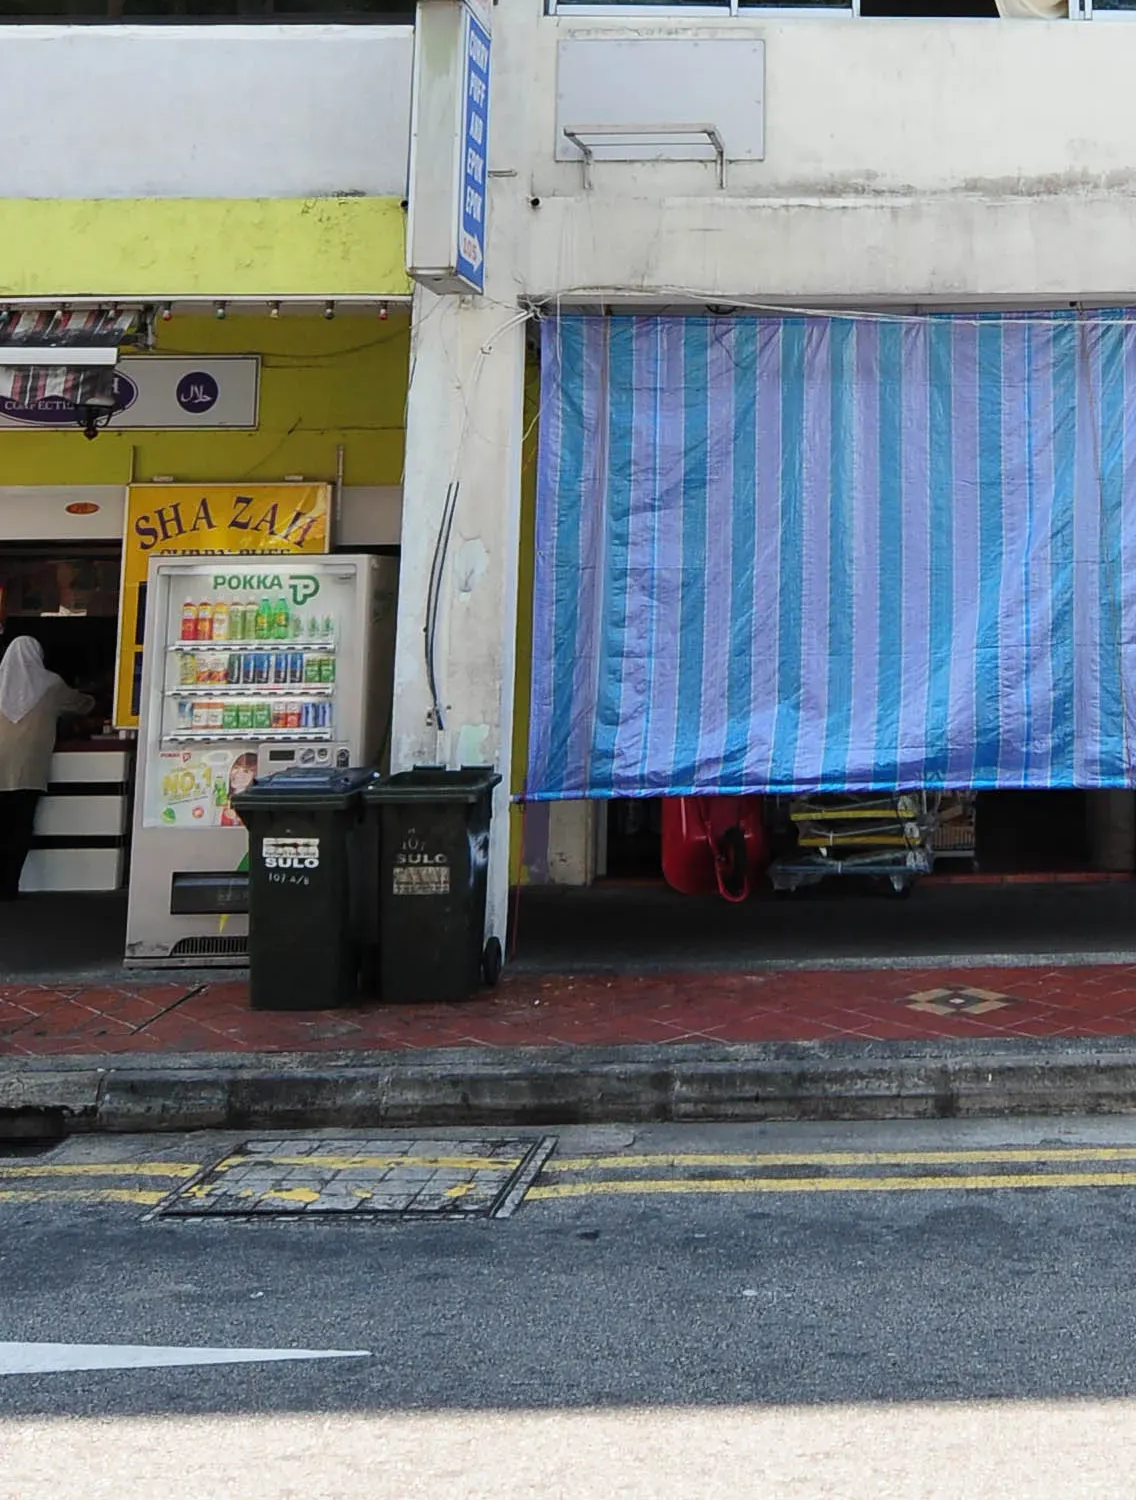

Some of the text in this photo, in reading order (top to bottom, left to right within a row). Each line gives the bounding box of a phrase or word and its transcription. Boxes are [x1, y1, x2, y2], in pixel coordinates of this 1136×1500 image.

[135, 495, 317, 550] SHA ZAH
[213, 575, 283, 590] POKKA
[264, 857, 320, 869] SULO
[397, 853, 447, 864] SULO
